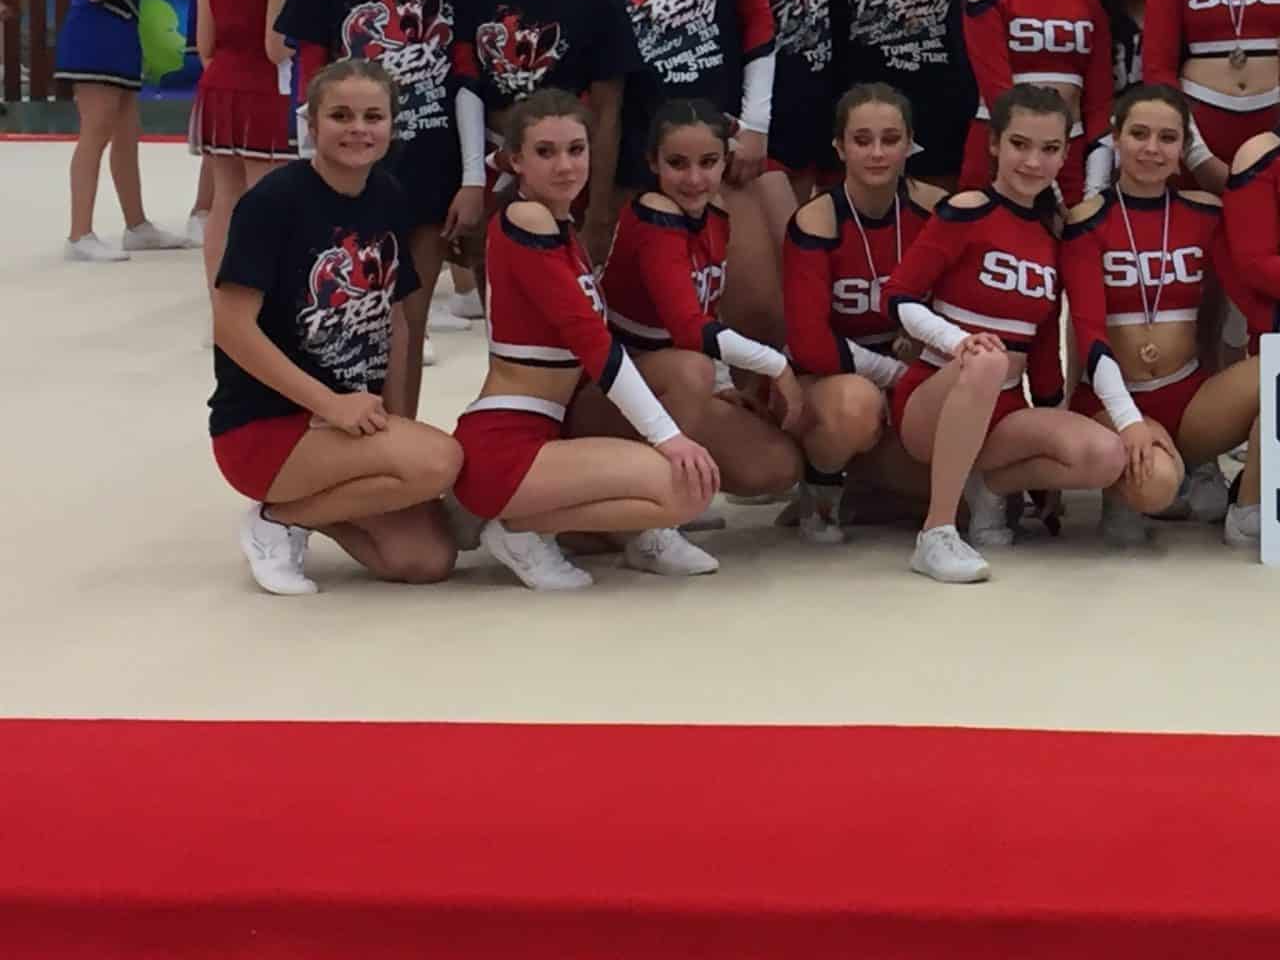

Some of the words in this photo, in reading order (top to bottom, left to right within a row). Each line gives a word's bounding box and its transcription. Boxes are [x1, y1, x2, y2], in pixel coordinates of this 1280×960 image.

[382, 35, 442, 74] REX
[1008, 17, 1094, 54] SCC
[1103, 246, 1203, 287] SCC
